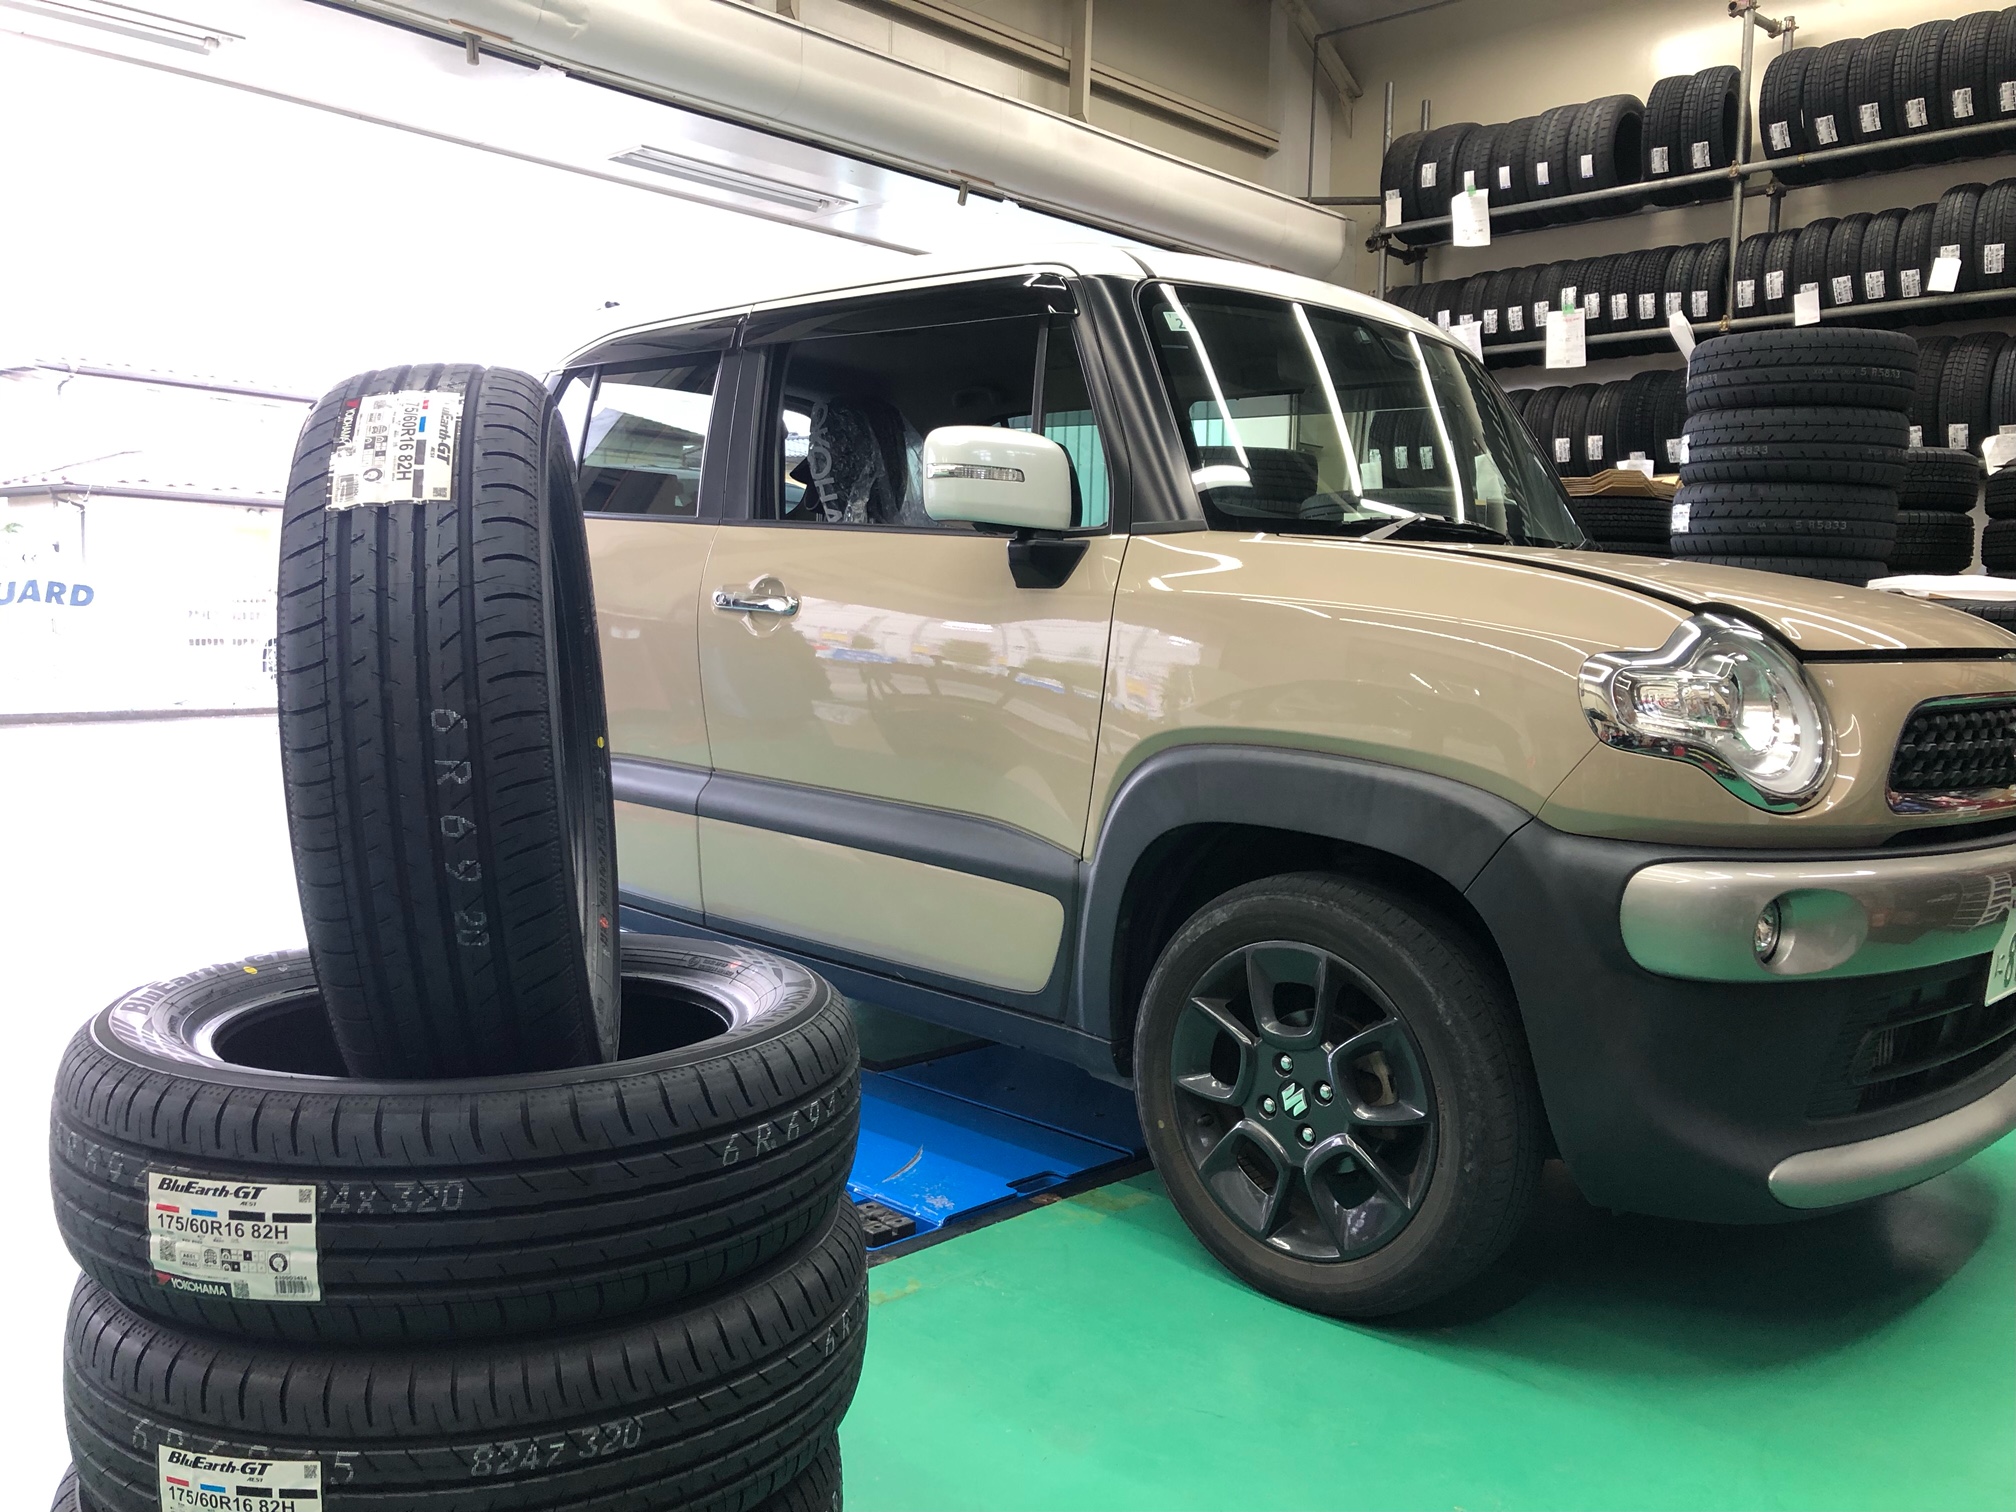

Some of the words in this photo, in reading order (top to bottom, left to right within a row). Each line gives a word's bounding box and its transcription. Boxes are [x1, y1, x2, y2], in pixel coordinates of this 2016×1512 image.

[399, 402, 420, 451] 75/60R16
[396, 455, 413, 481] 82H
[158, 1177, 267, 1200] BluEarth-GT
[157, 1213, 245, 1238] 175/60R16
[251, 1224, 288, 1240] 82H
[170, 1277, 228, 1297] YOKOHAMA
[167, 1450, 273, 1476] BluEarth-GT
[168, 1485, 253, 1512] 175/60R16
[259, 1500, 295, 1512] 82H
